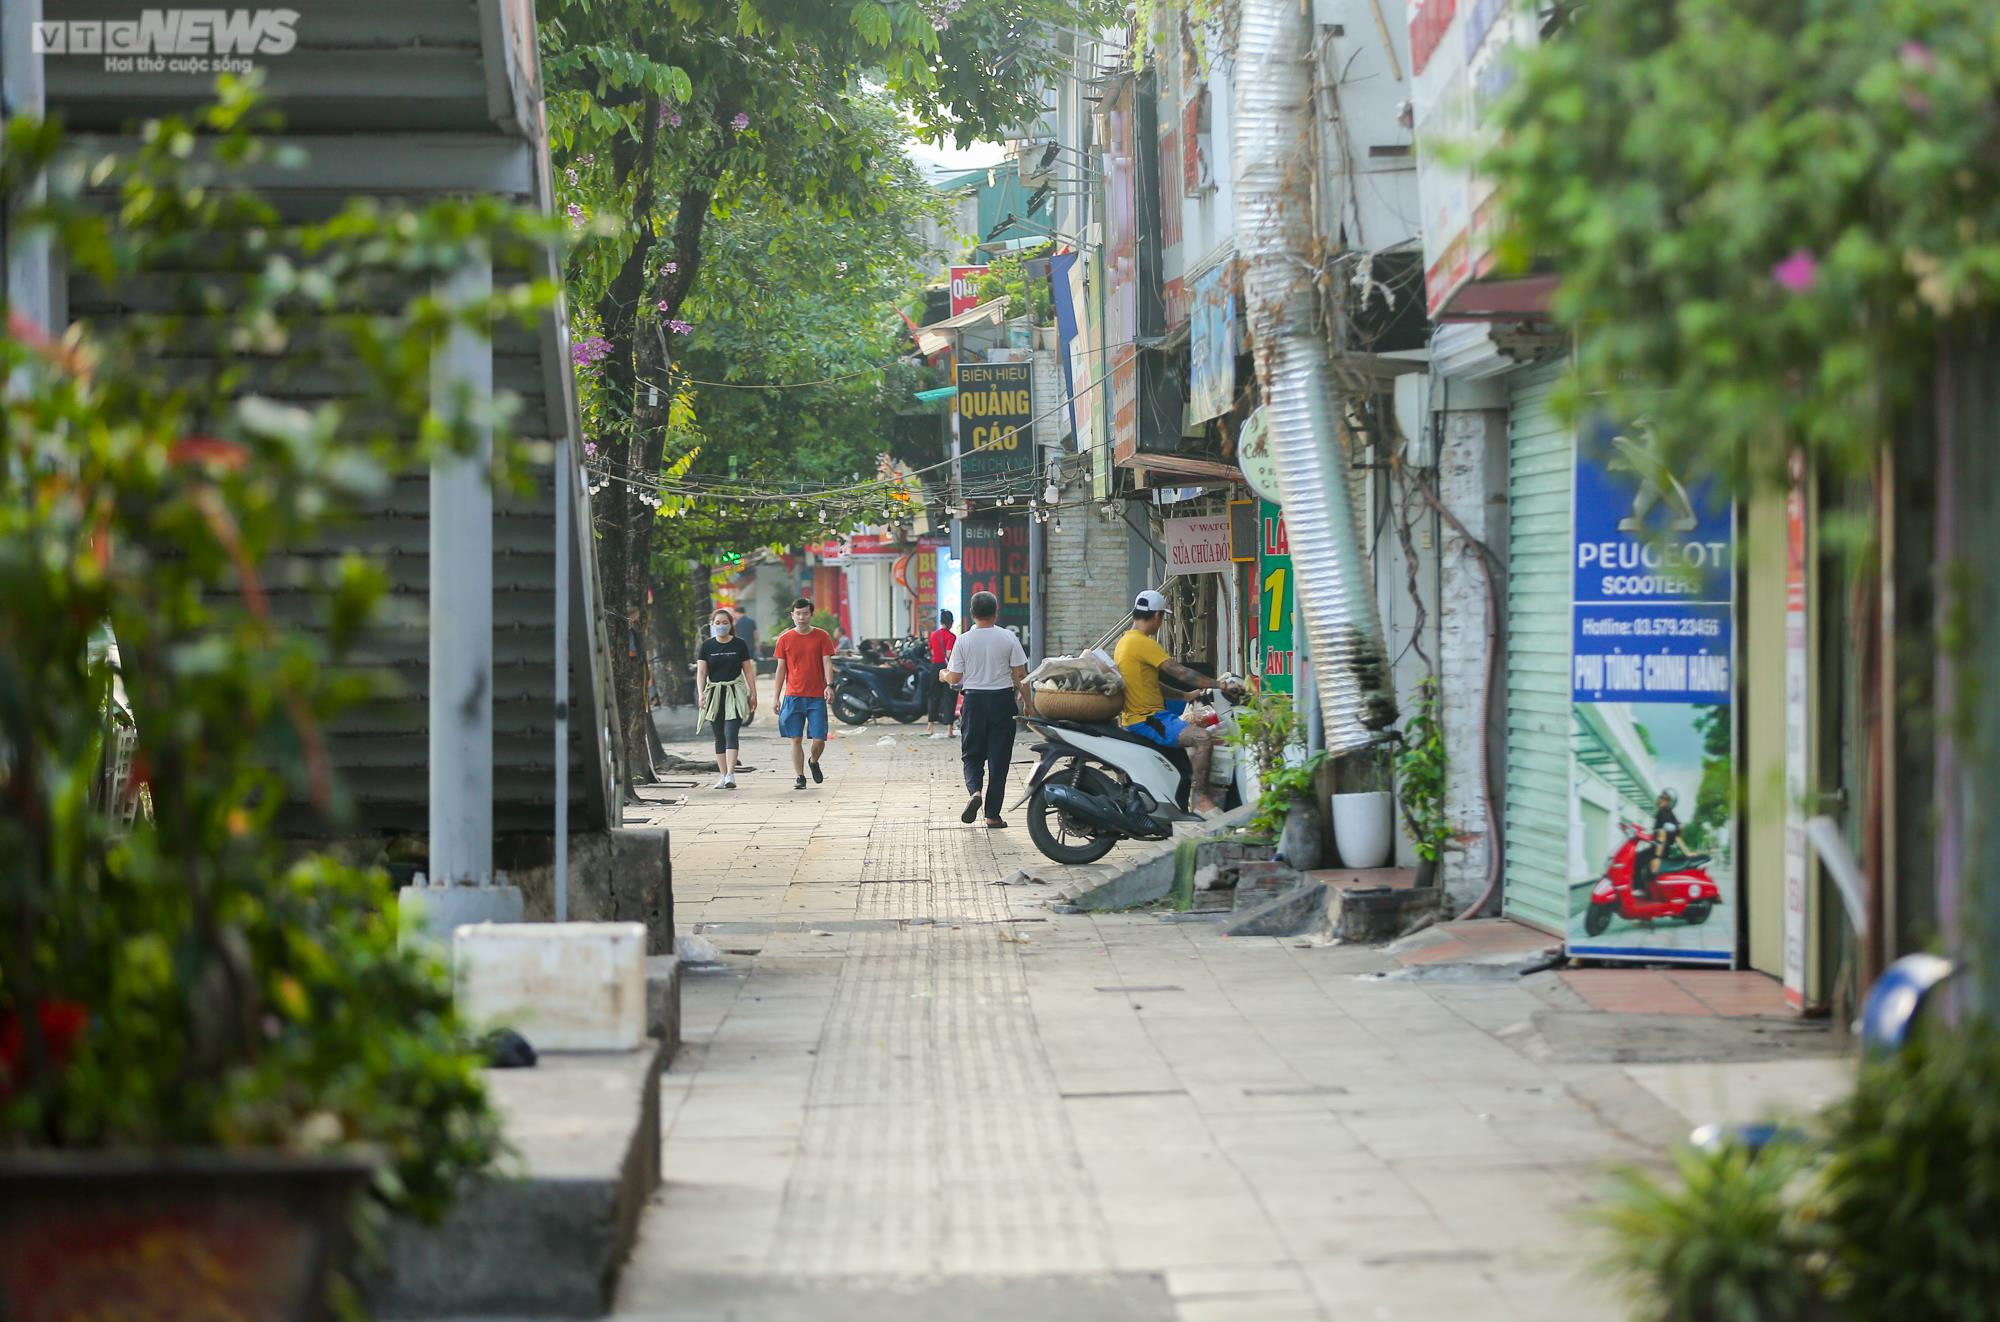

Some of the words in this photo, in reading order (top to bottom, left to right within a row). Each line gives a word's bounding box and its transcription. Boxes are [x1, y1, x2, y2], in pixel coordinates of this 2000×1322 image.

[960, 384, 1030, 420] QUẢNG
[972, 421, 1018, 452] CÁO
[1578, 541, 1727, 570] PEUGEOT
[1601, 575, 1701, 595] SCOOTERS
